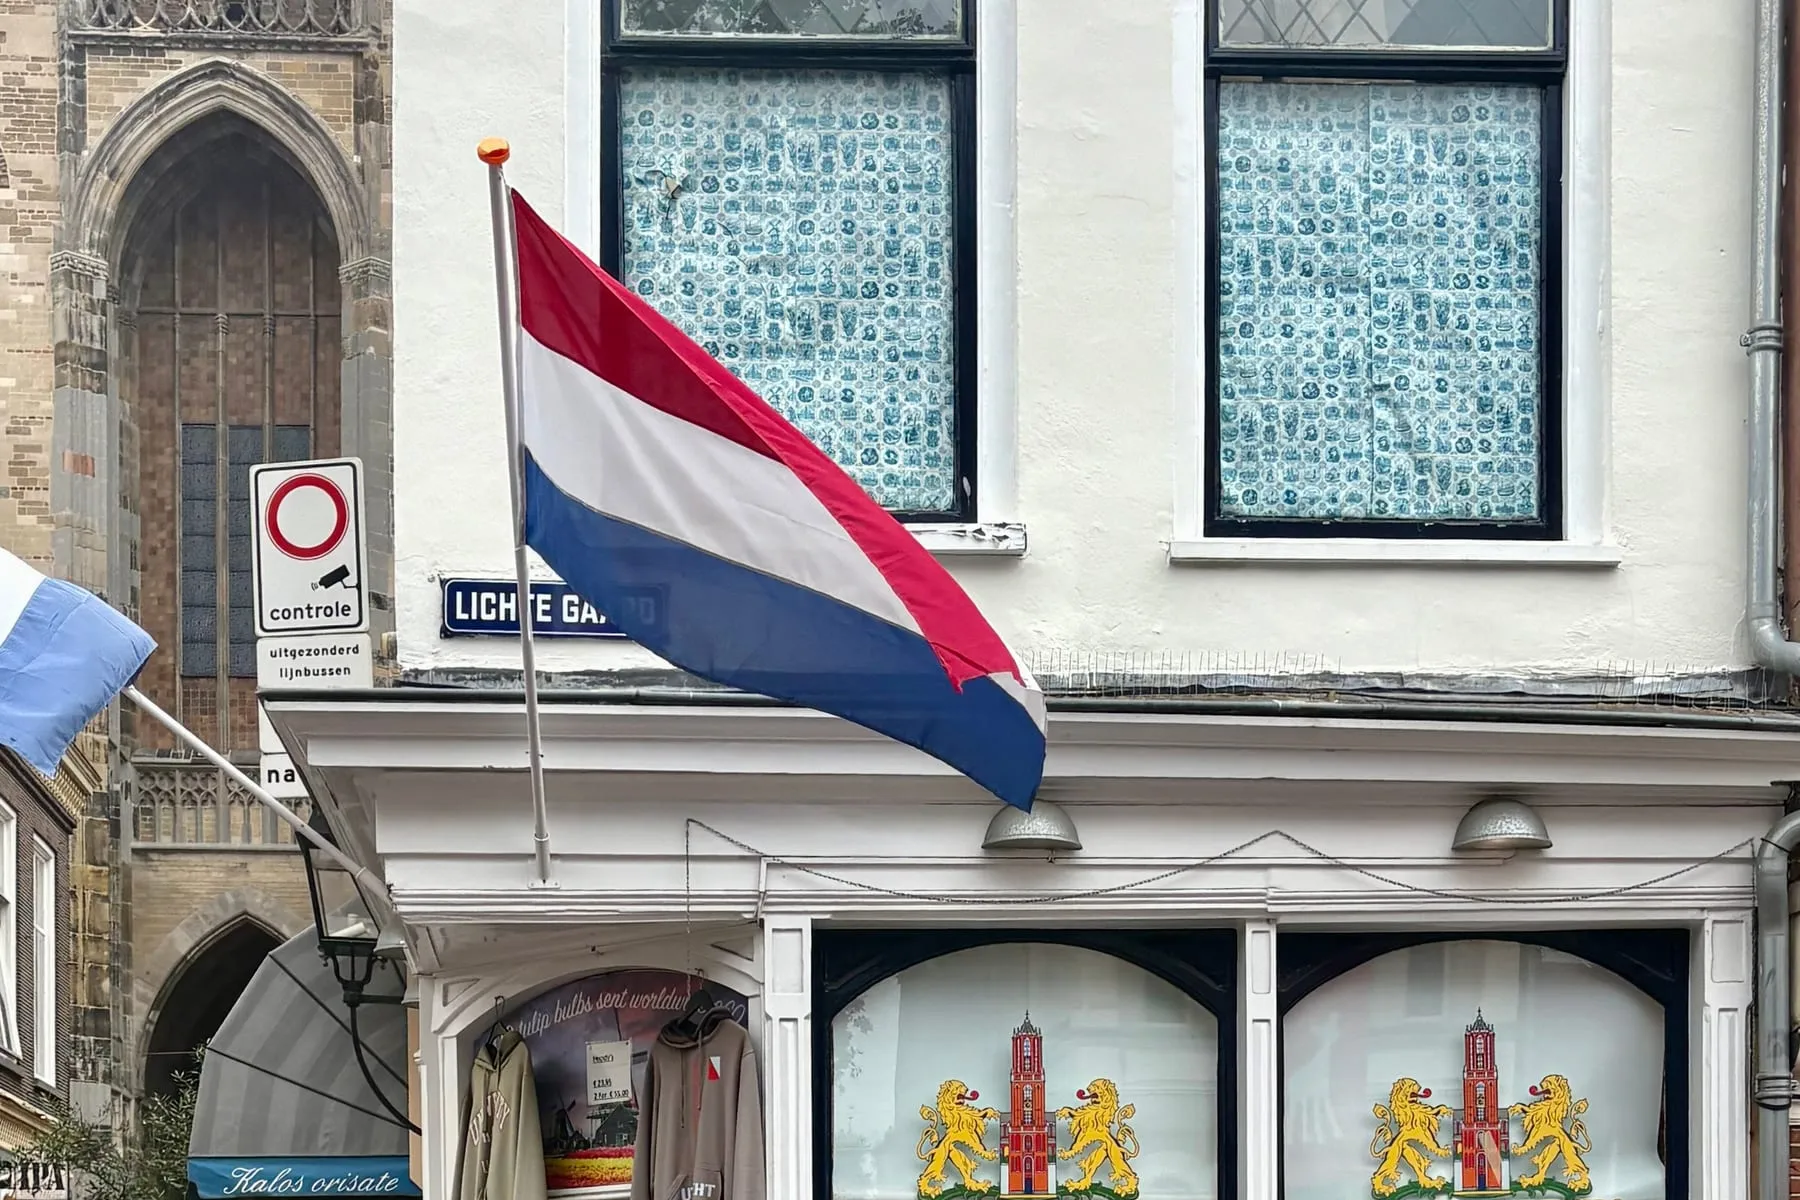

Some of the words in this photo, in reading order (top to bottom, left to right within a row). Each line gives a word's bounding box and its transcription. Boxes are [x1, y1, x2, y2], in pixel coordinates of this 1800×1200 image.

[270, 601, 351, 620] controle
[270, 644, 359, 660] uitgezonderd
[280, 666, 351, 681] lijnbussen
[268, 768, 295, 783] na
[554, 992, 593, 1022] bulbs
[596, 988, 628, 1010] sent
[630, 986, 689, 1011] worldwi
[223, 1167, 304, 1194] Kalos
[311, 1172, 399, 1193] orisate
